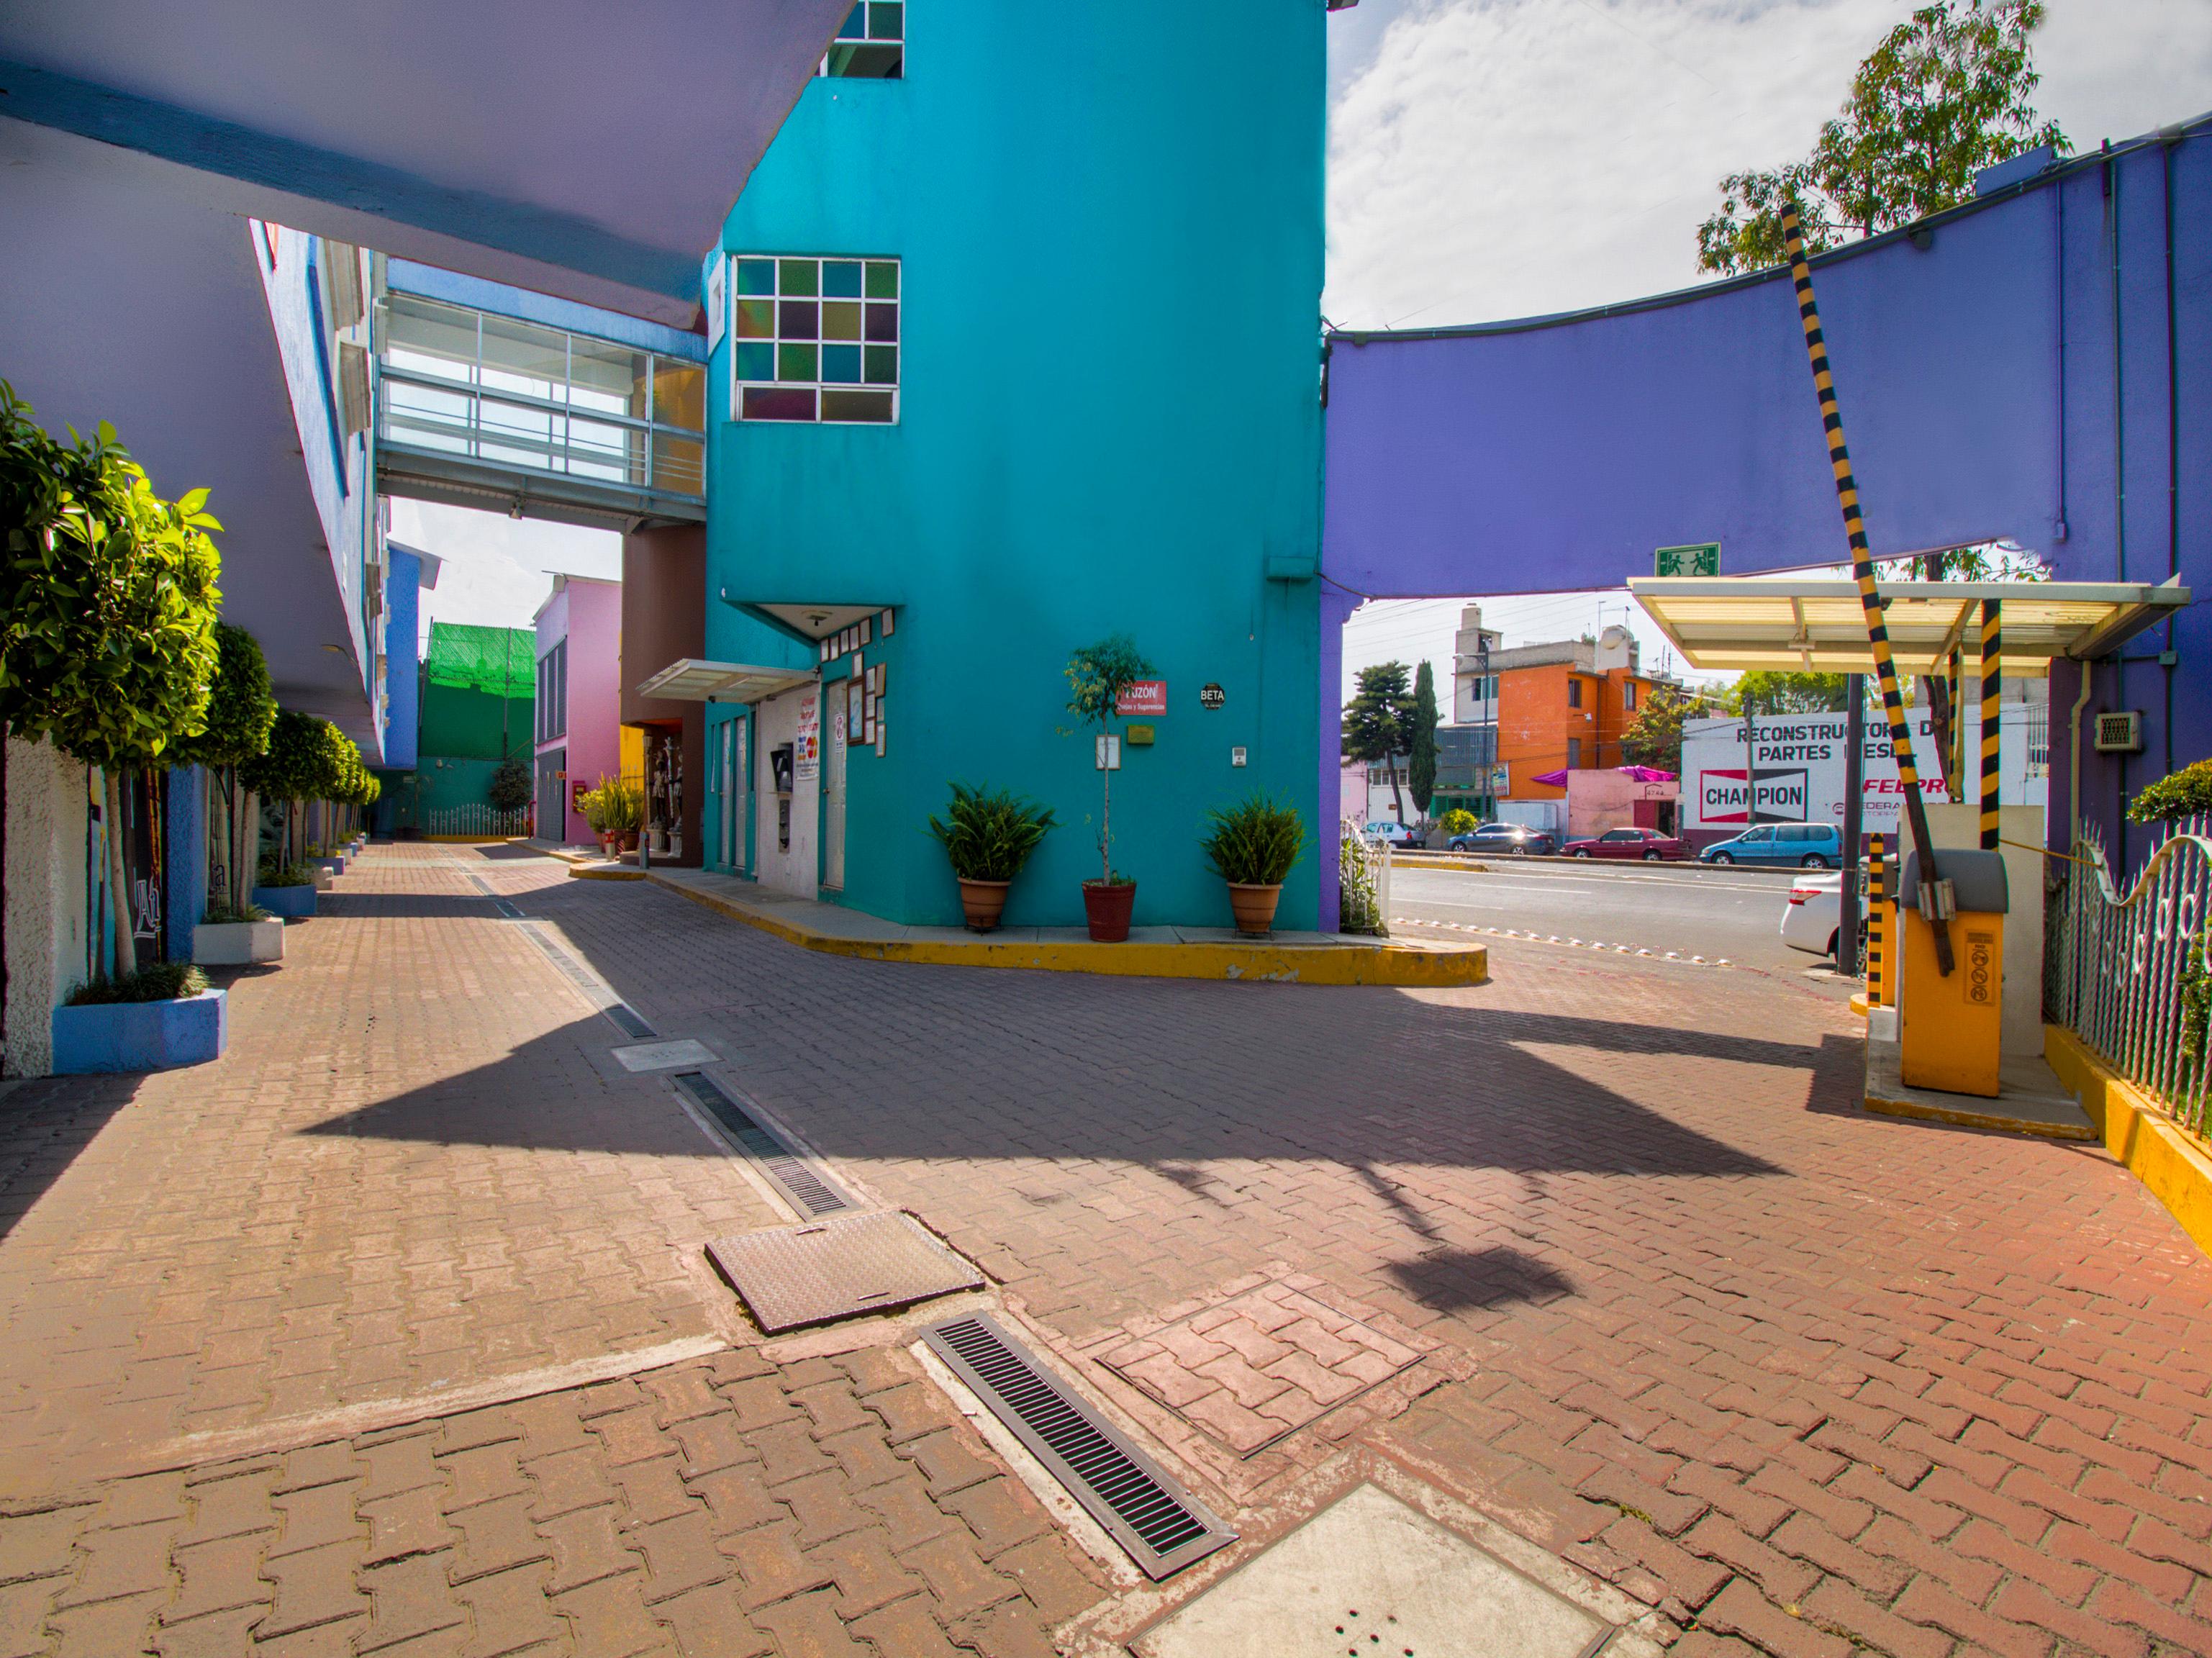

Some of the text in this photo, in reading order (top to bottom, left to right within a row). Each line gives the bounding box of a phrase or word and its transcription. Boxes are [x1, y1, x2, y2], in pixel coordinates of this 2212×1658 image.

[1200, 690, 1225, 701] BETA
[1759, 745, 1831, 761] PARTES
[1705, 787, 1802, 805] CHAMPION
